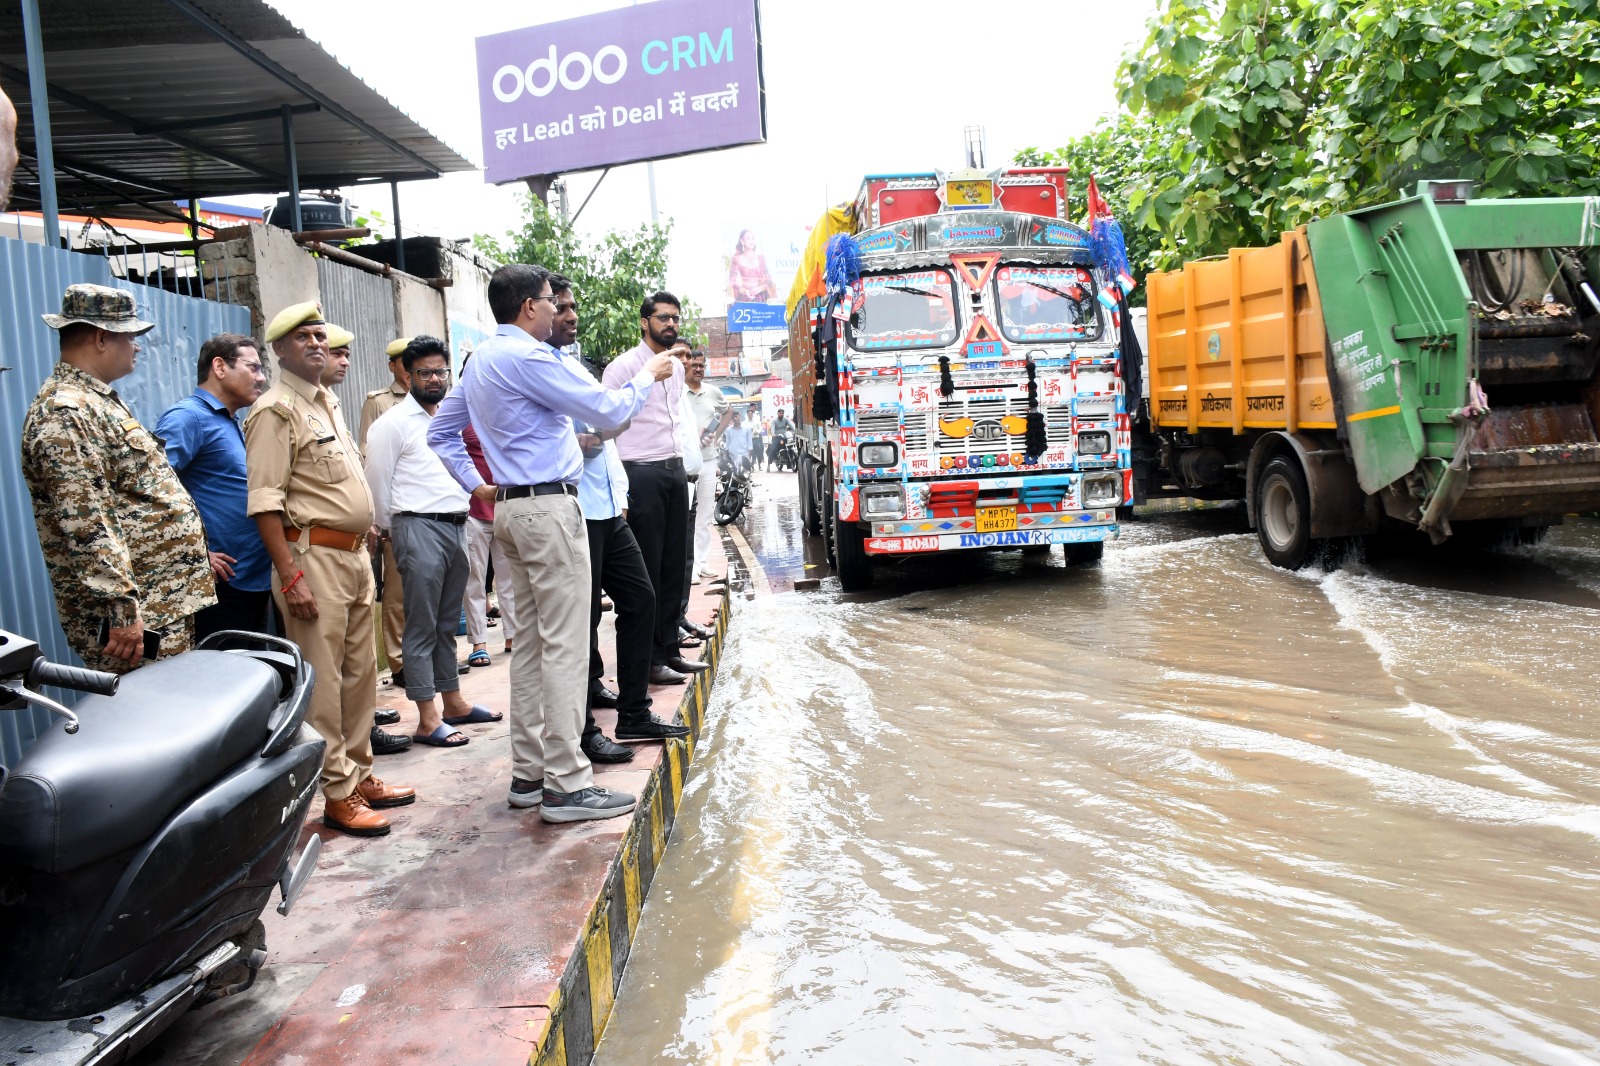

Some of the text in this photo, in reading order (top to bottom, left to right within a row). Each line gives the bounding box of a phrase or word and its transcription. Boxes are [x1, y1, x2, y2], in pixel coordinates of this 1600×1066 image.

[492, 27, 734, 103] odoo CRM
[494, 82, 739, 150] हर Lead को Deal में बदलें
[735, 309, 751, 323] 25
[1246, 395, 1285, 411] प्रयागराज
[983, 519, 1015, 530] HH4377
[902, 536, 938, 551] ROAD
[960, 531, 1030, 547] INDIAN
